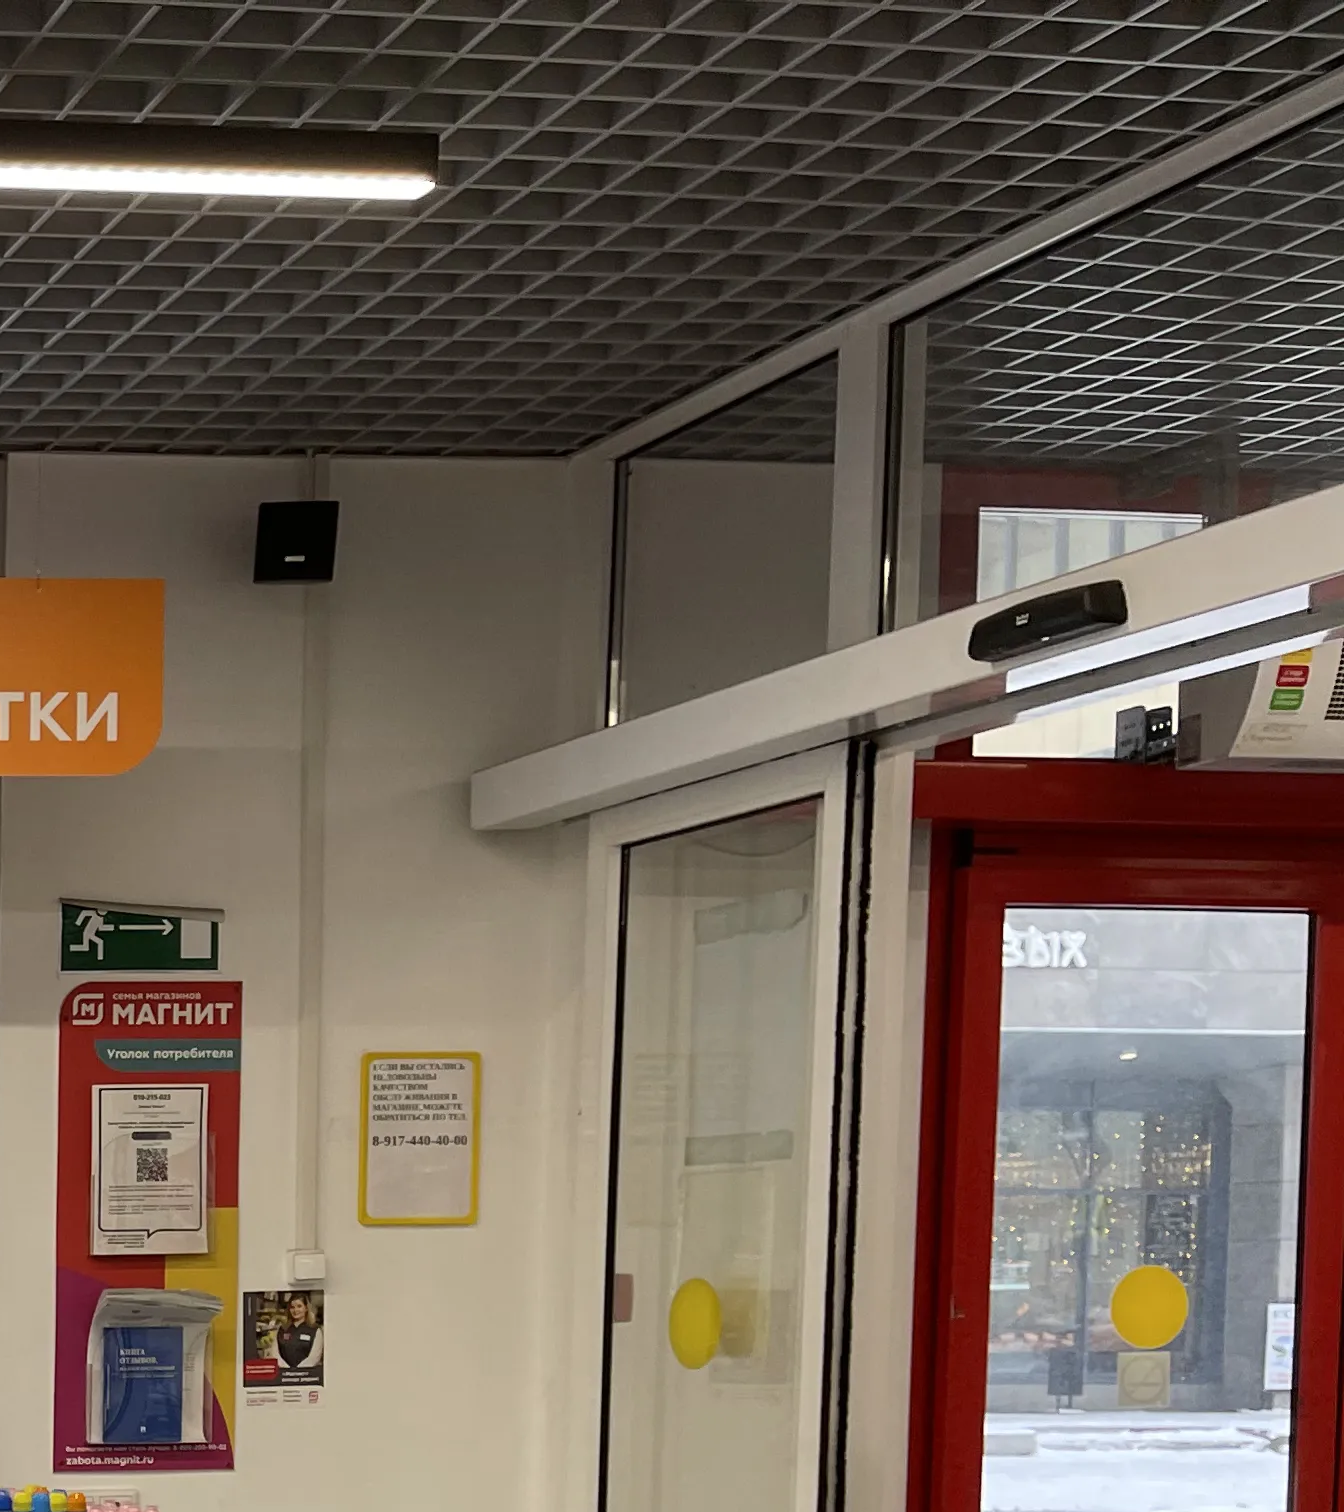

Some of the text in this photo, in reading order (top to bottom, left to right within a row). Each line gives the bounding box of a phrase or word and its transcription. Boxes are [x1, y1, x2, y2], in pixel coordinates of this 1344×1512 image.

[146, 992, 201, 1000] магазинов
[113, 1003, 233, 1025] МАГНИТ
[107, 1048, 234, 1061] Уголок потребителя
[373, 1136, 467, 1146] 8-917-440-40-00
[66, 1456, 154, 1466] zabota.magnit.ru
